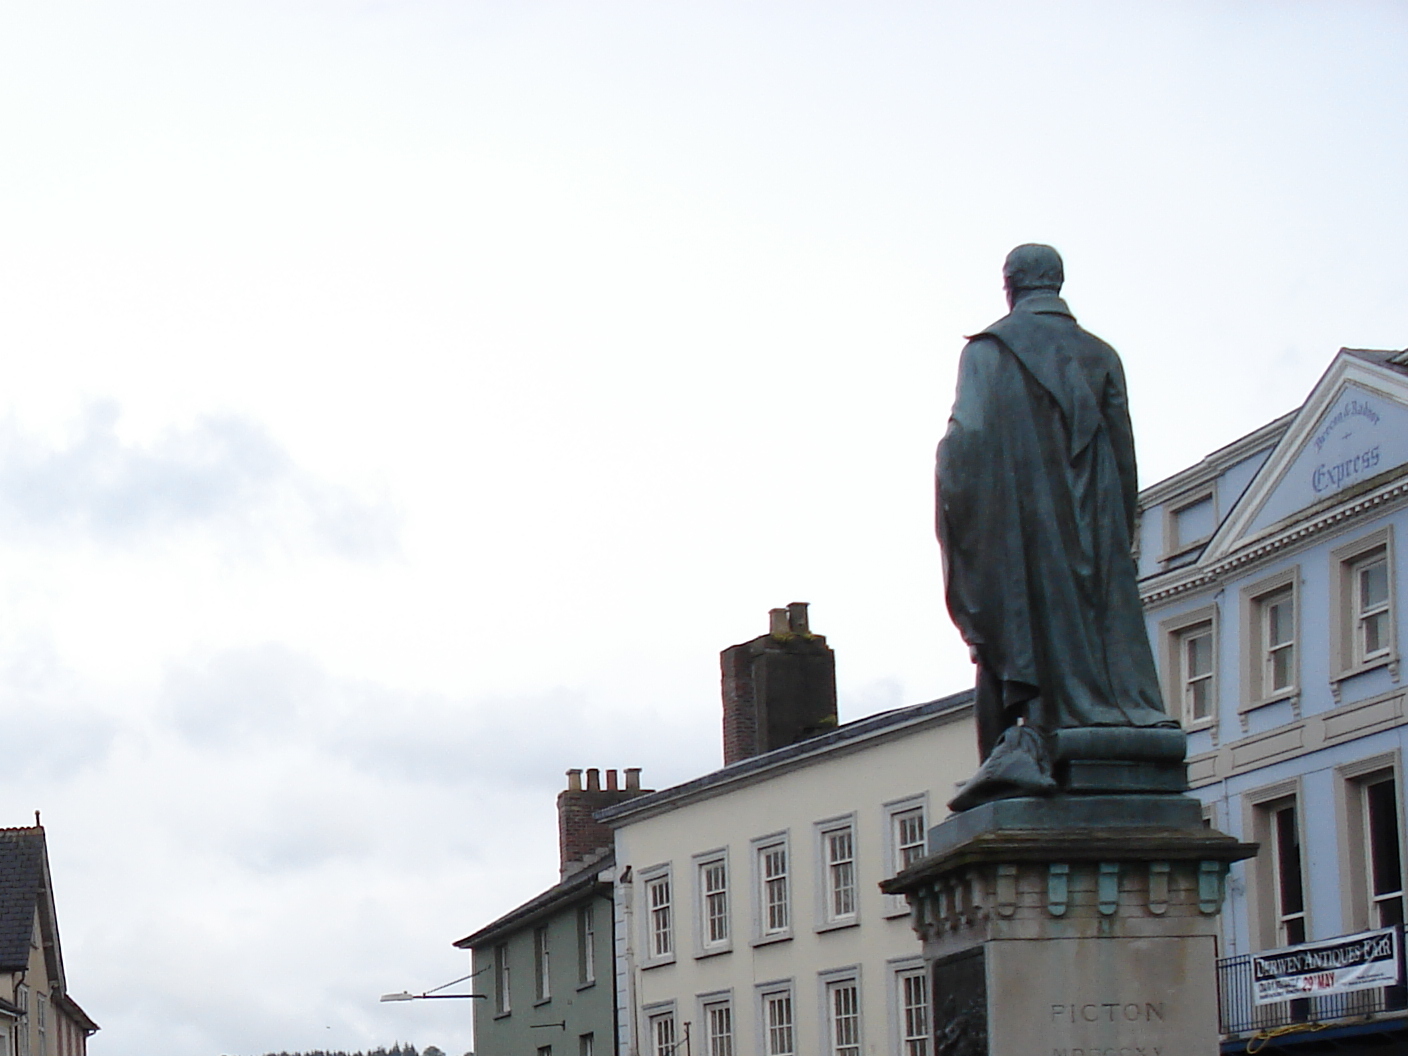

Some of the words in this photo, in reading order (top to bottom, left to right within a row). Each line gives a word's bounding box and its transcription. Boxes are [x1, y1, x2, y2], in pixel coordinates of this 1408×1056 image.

[1315, 411, 1344, 454] Brecon
[1312, 445, 1380, 493] Express
[1303, 942, 1361, 971] ANTIQUES
[1317, 971, 1335, 990] MAY
[1051, 1002, 1166, 1024] PICTON
